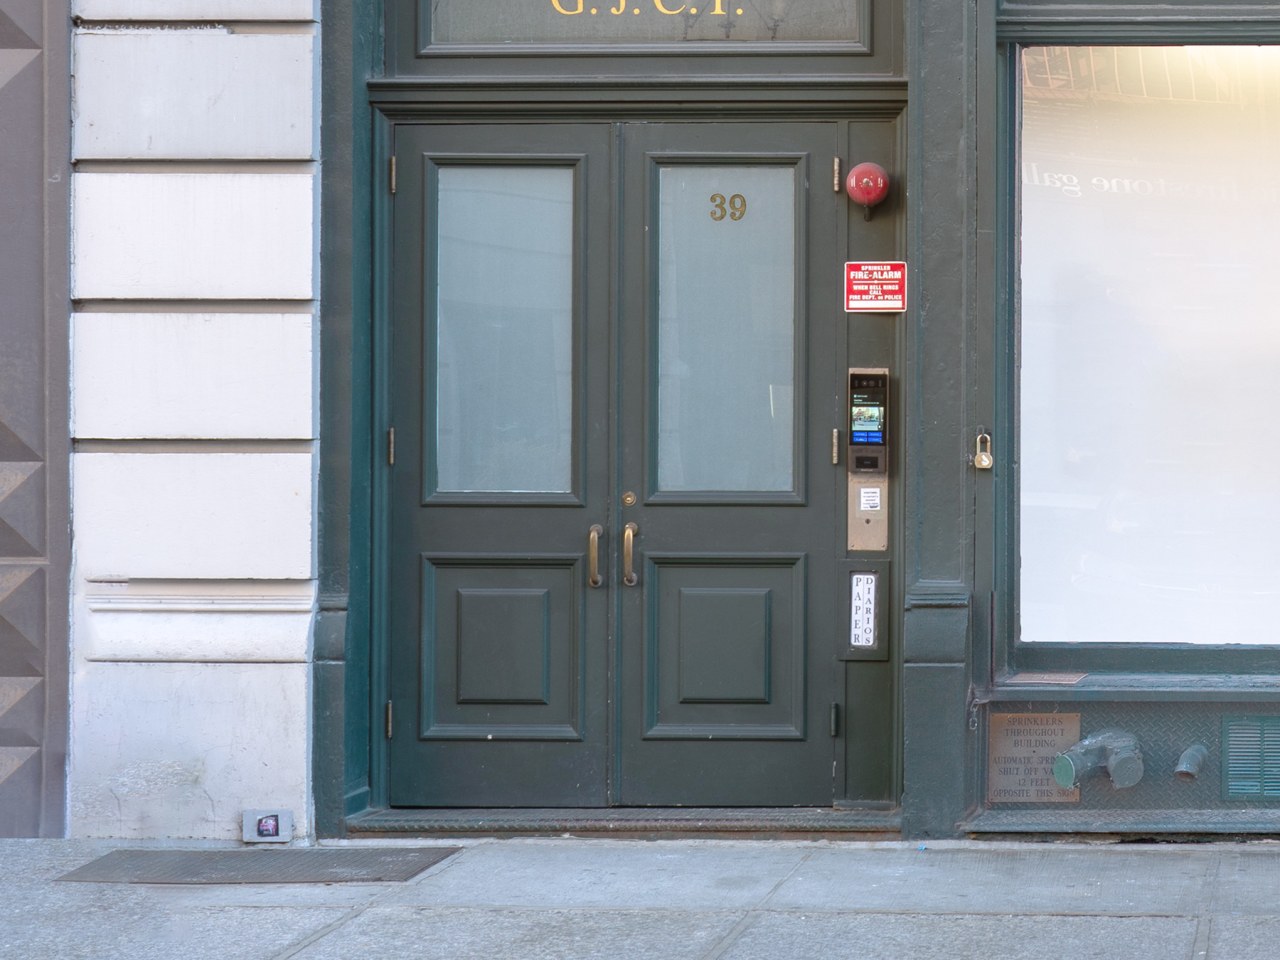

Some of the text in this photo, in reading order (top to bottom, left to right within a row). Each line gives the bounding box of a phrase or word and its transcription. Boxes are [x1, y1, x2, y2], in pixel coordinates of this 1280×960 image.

[709, 193, 748, 222] 39
[850, 271, 902, 279] FIRE-ALARM
[853, 577, 862, 644] PAPER
[864, 577, 874, 645] DIARIOS
[1007, 717, 1063, 726] SPRINKLERS
[1005, 728, 1065, 737] THROUGHOUT
[1014, 740, 1056, 748] BUILDING
[998, 767, 1020, 776] SHUT
[1030, 778, 1050, 787] FEET
[993, 789, 1031, 798] OPPOSITE
[1036, 789, 1053, 798] THIS
